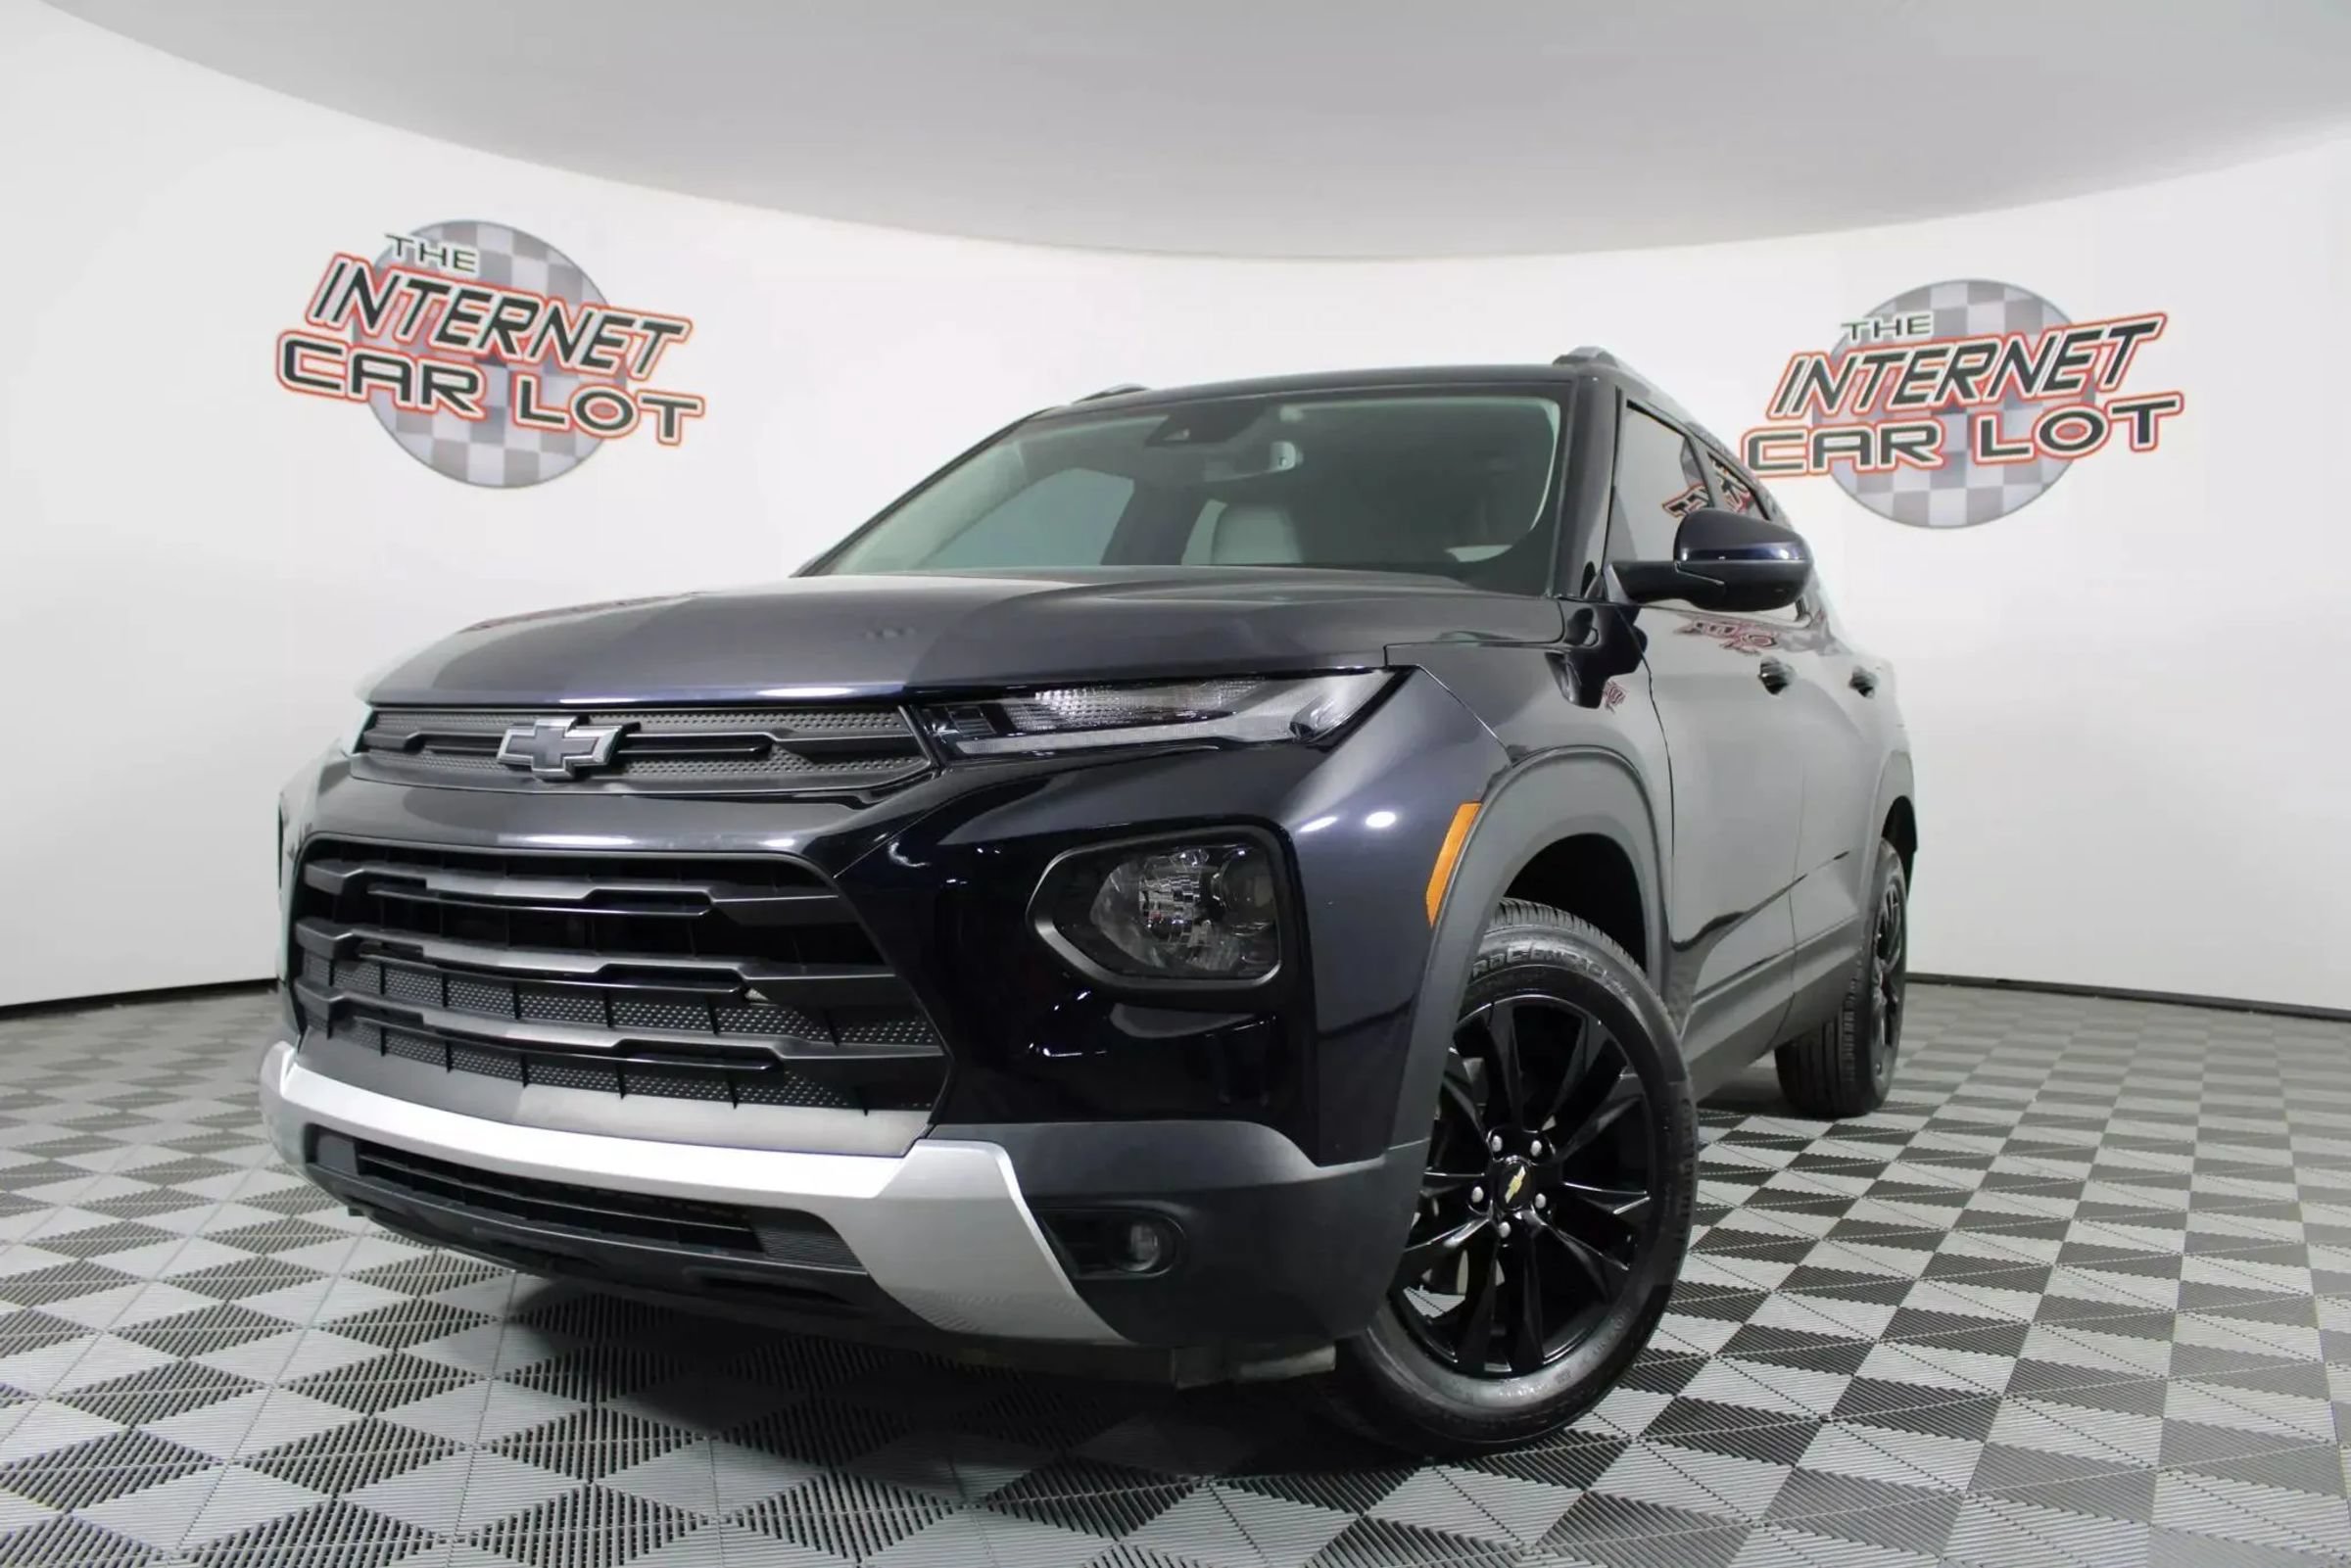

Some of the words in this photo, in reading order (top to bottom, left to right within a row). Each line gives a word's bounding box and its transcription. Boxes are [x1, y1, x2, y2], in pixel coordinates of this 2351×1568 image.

[385, 232, 478, 274] THE
[308, 255, 691, 380] INTERNET
[1840, 312, 1933, 342] THE
[278, 332, 485, 416] CAR
[516, 375, 701, 443] LOT
[1768, 315, 2164, 417] INTERNET
[1743, 421, 1943, 477] CAR
[1976, 394, 2181, 464] LOT
